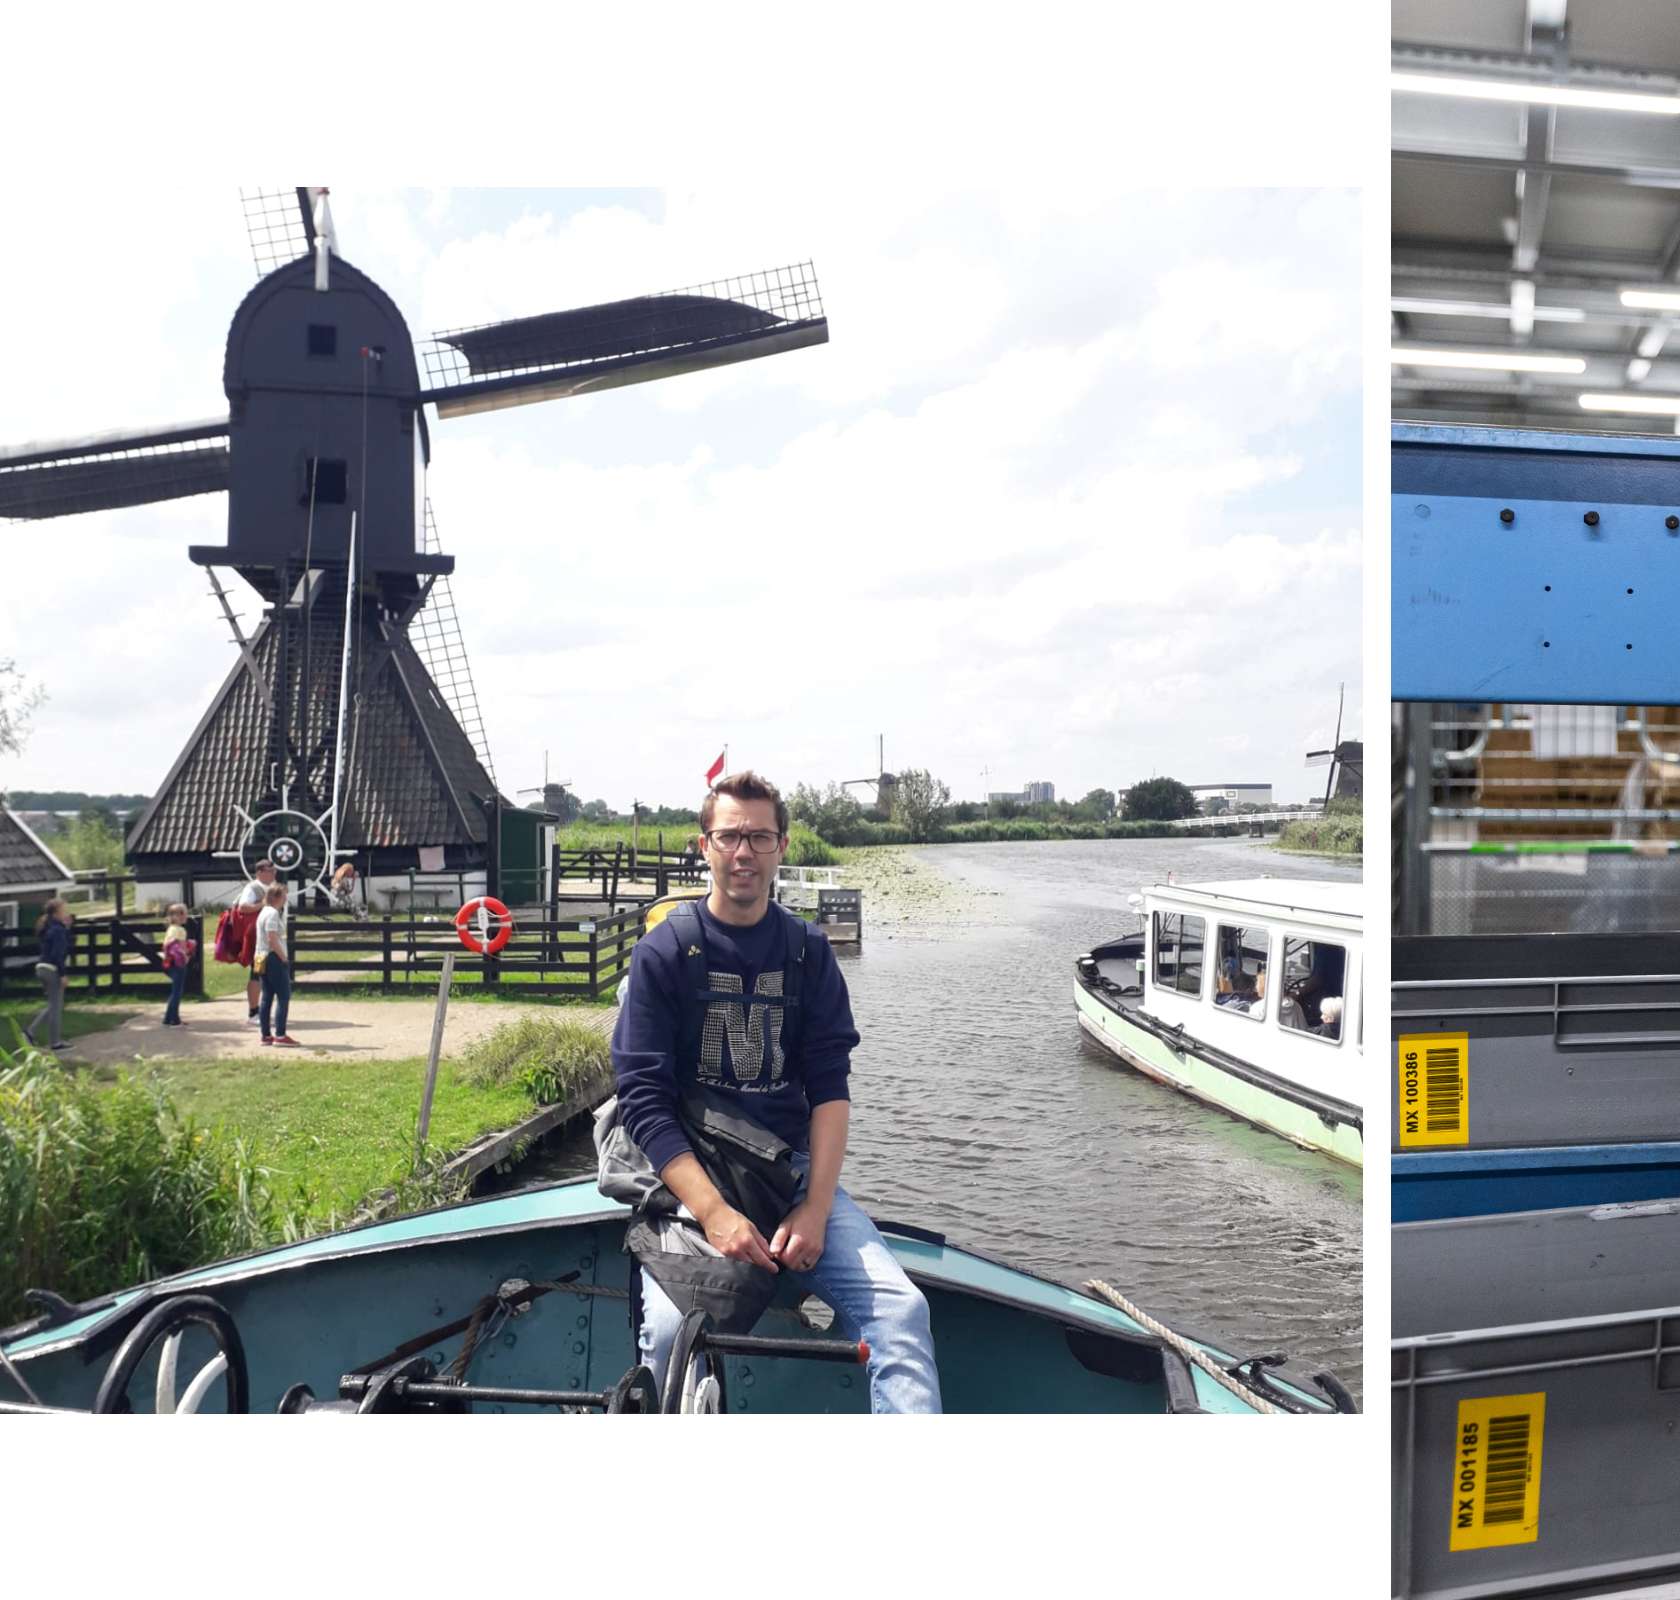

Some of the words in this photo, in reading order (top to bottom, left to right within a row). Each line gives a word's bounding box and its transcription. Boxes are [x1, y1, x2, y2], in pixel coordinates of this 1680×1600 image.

[1405, 1051, 1418, 1106] 100386
[1405, 1110, 1419, 1133] MX
[1460, 1422, 1479, 1492] 001185
[1457, 1498, 1474, 1528] MX
